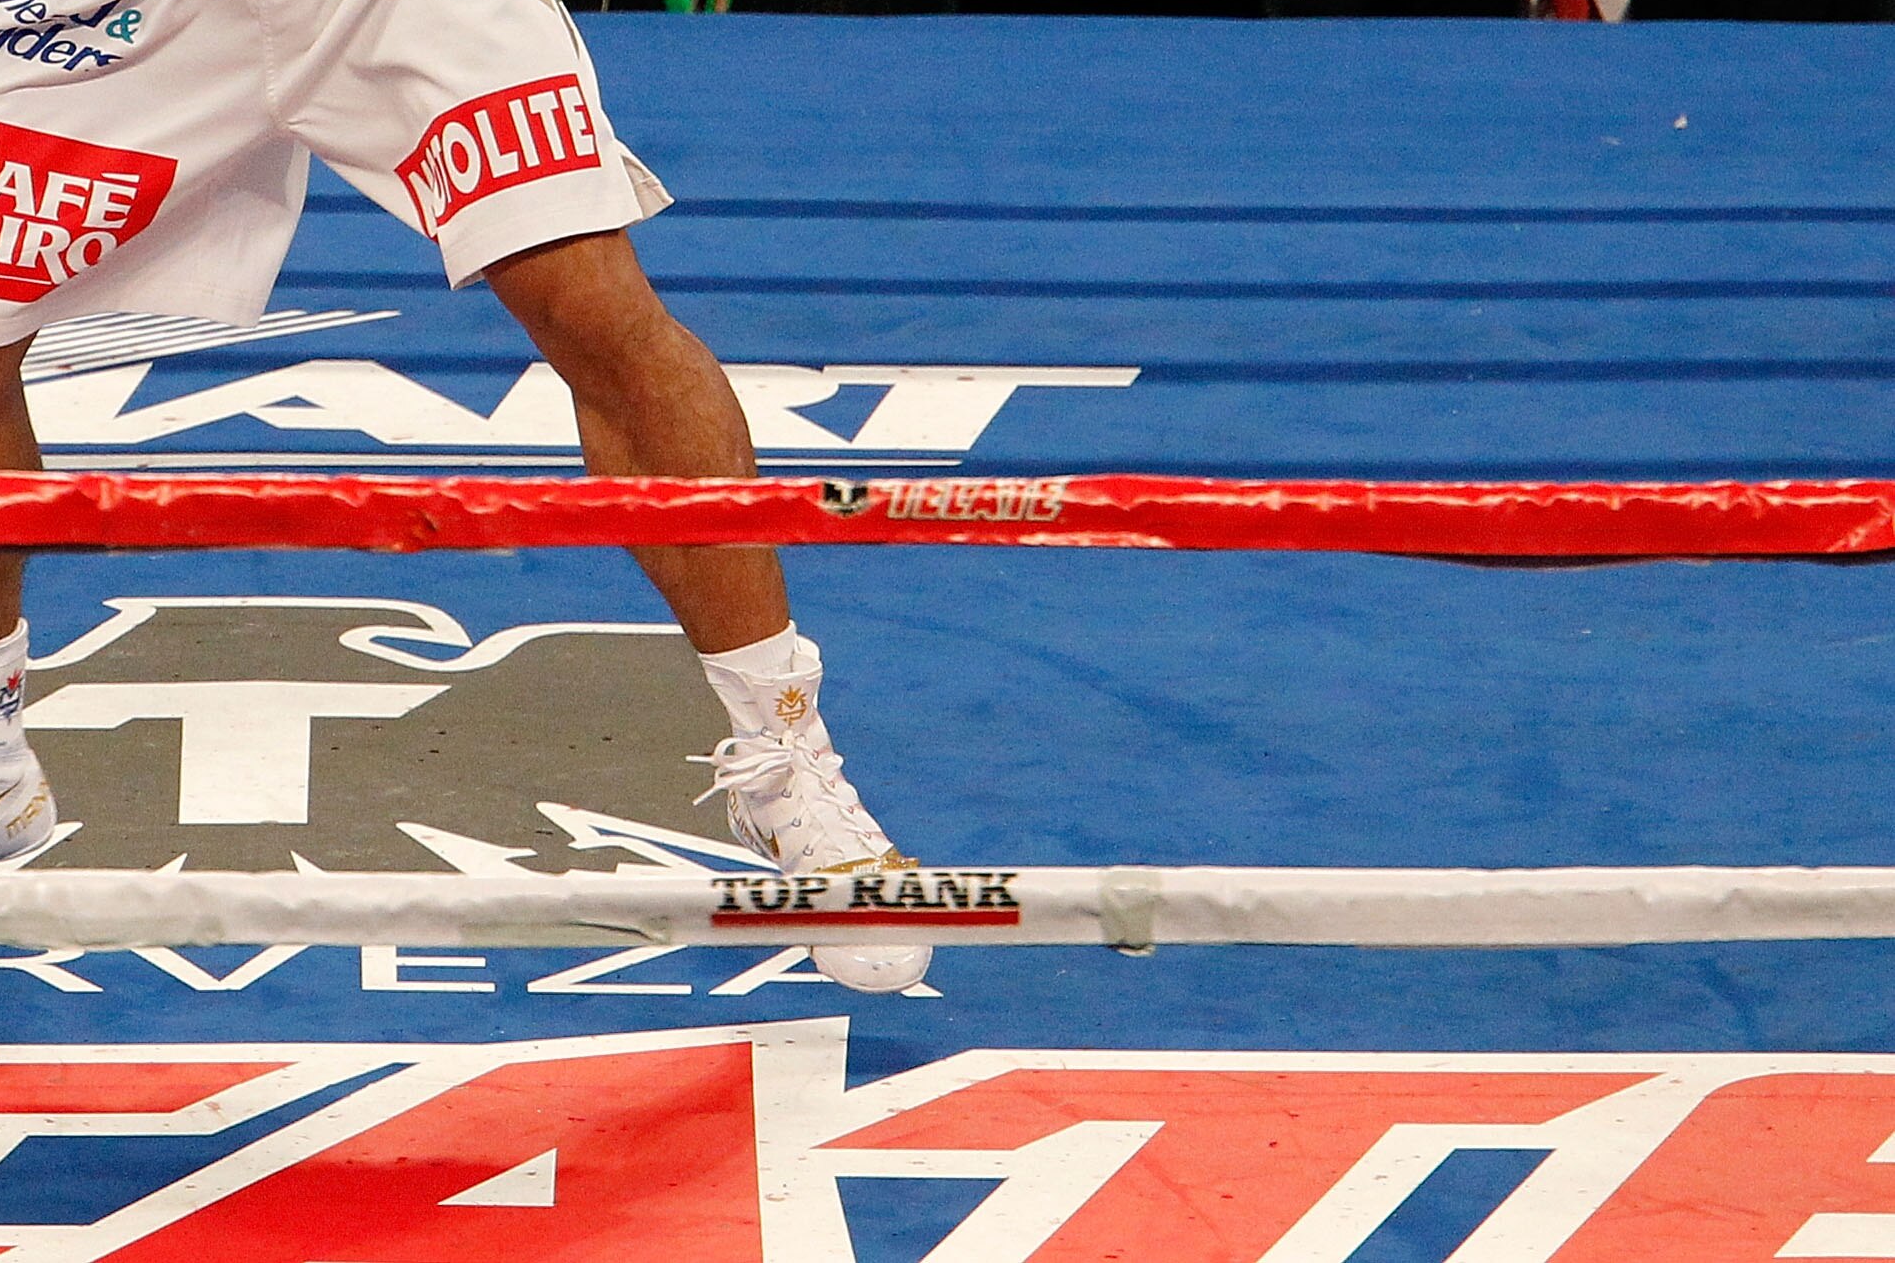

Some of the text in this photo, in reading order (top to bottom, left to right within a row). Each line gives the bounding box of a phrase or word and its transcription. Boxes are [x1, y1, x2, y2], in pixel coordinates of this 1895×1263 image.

[105, 9, 143, 45] &
[710, 874, 1018, 912] TOP RANK
